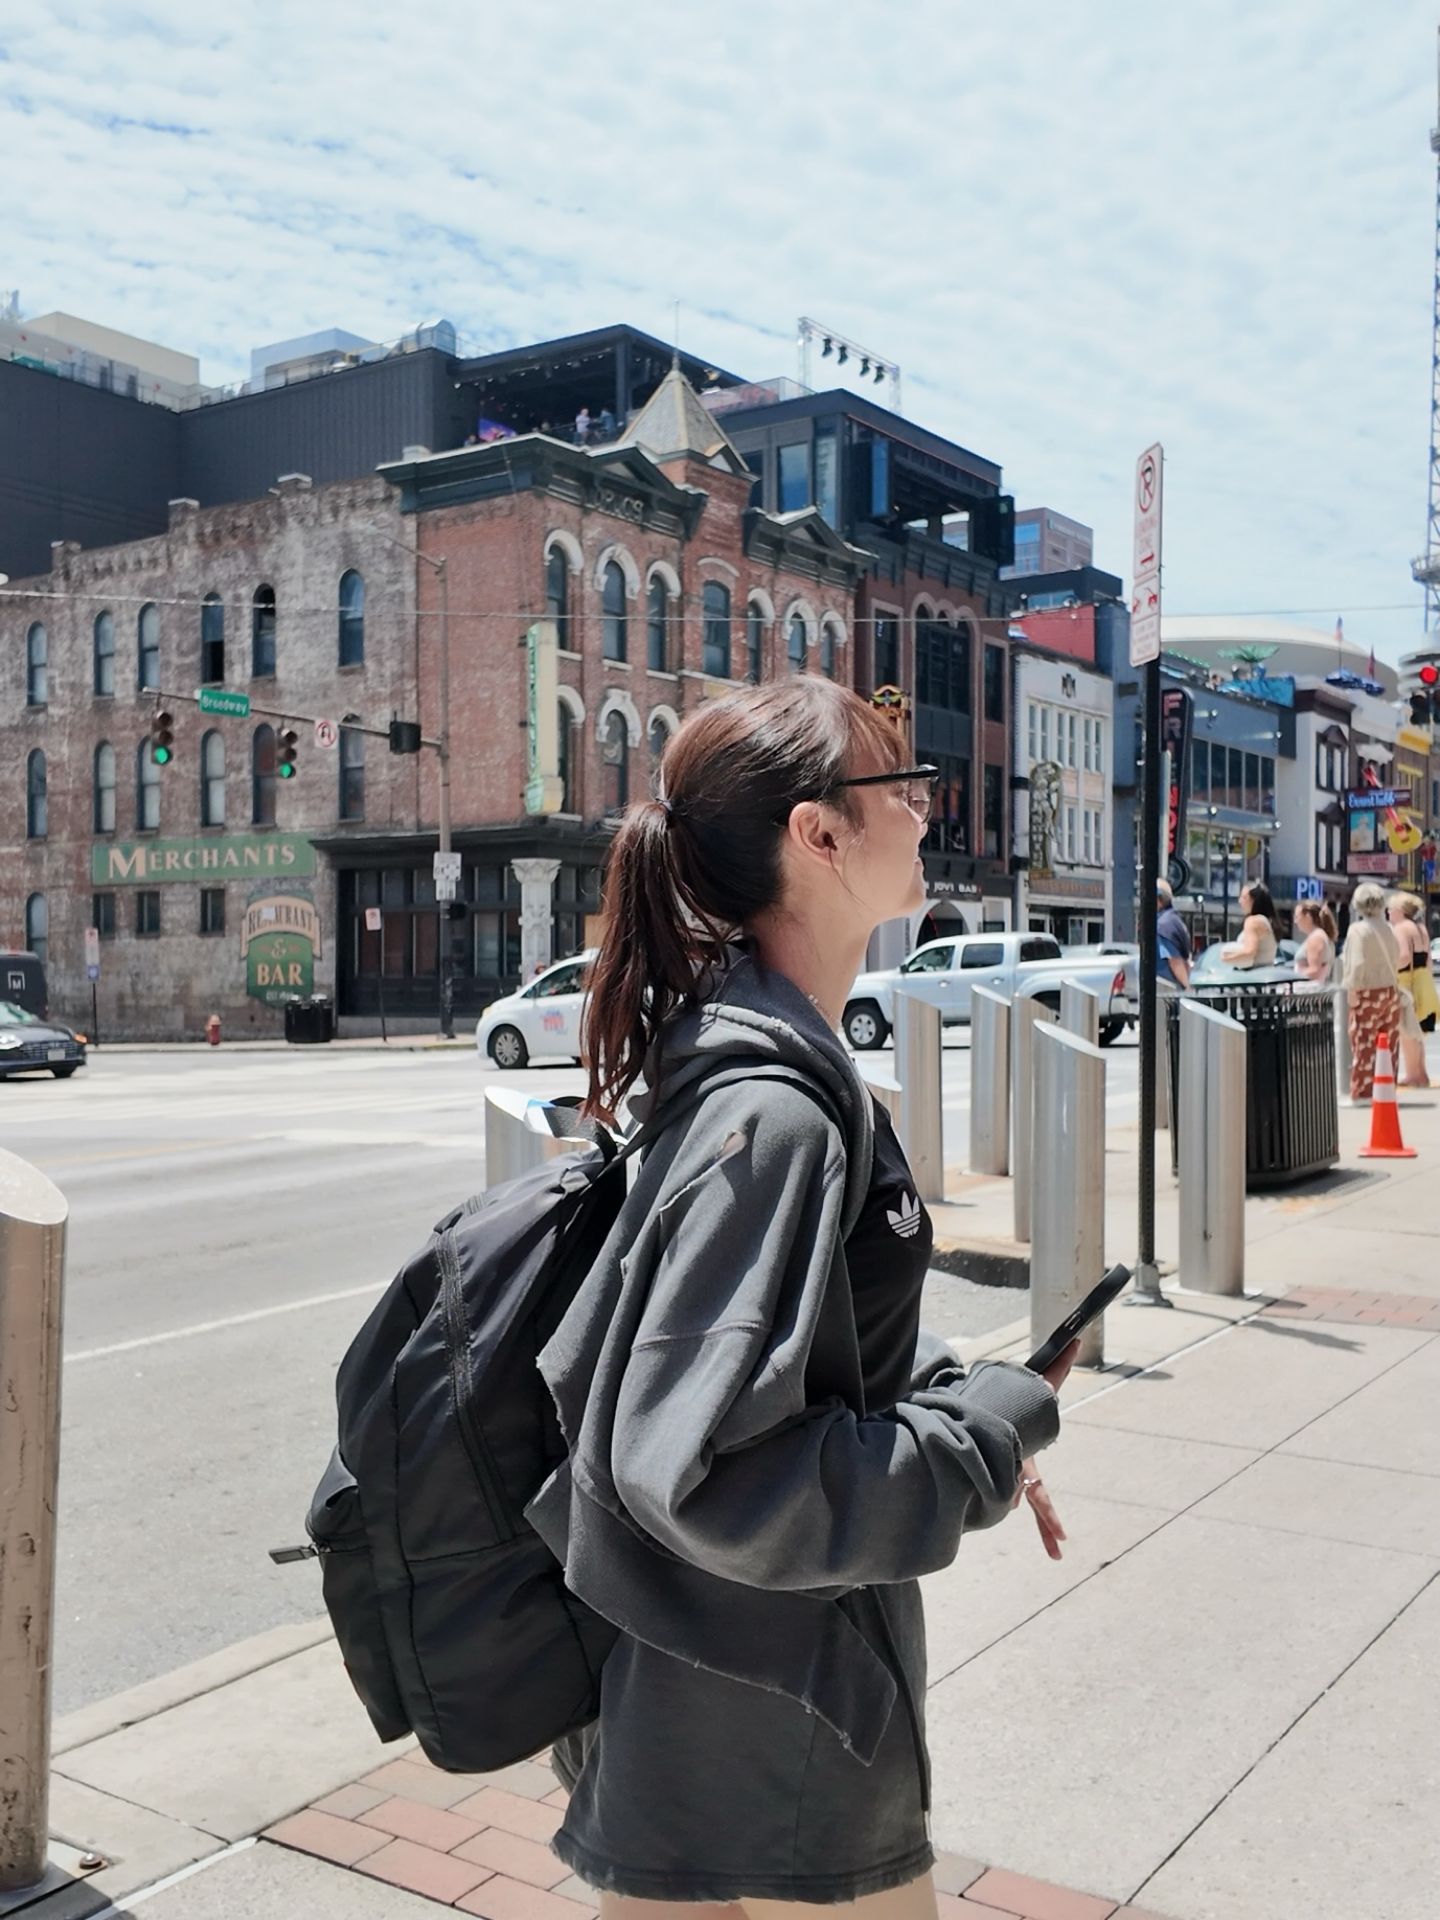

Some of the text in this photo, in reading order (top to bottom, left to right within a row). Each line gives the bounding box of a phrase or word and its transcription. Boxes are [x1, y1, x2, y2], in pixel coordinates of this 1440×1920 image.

[202, 694, 248, 715] Broadway
[108, 844, 296, 879] MERCHANTS
[934, 881, 955, 893] JOVI
[959, 883, 978, 893] BAR
[271, 939, 287, 960] &
[257, 963, 304, 986] BAR
